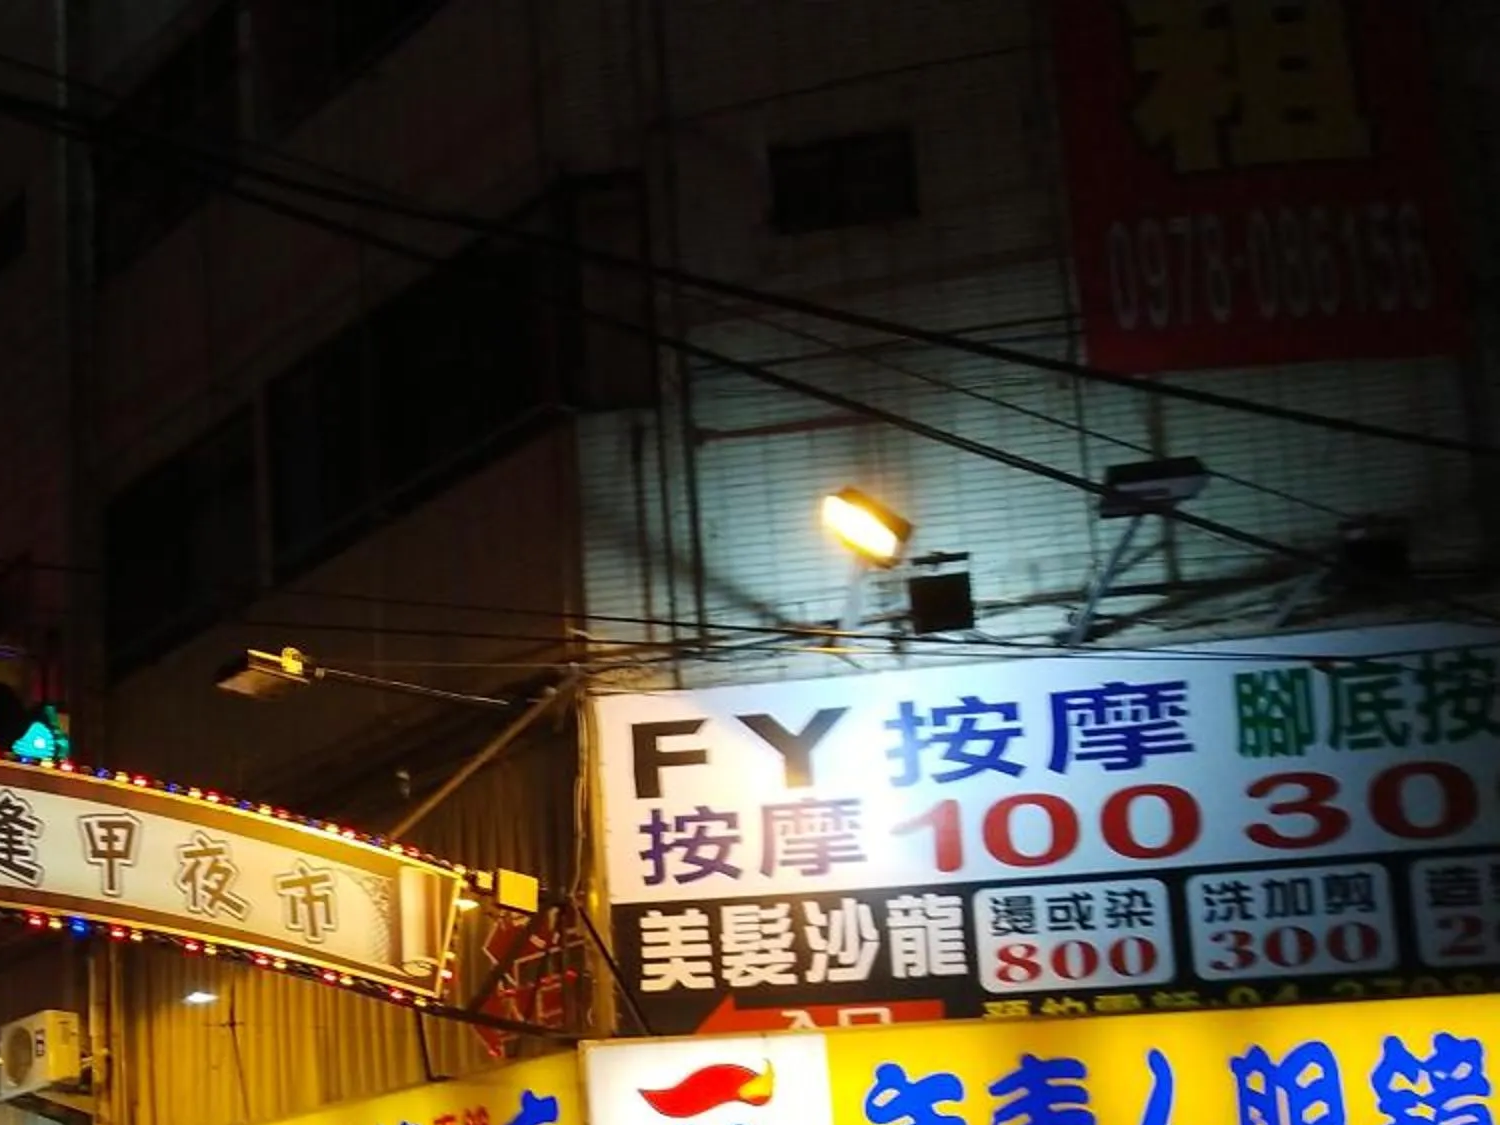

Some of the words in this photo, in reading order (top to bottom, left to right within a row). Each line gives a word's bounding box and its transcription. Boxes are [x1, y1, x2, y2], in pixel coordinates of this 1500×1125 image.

[632, 707, 849, 800] FY
[886, 678, 1193, 788] 按摩
[638, 797, 869, 887] 按摩
[889, 782, 1203, 876] 100
[1203, 871, 1377, 926] 洗加剪
[638, 893, 971, 995] 美髮沙龍
[994, 934, 1160, 987] 800
[1206, 916, 1383, 974] 300
